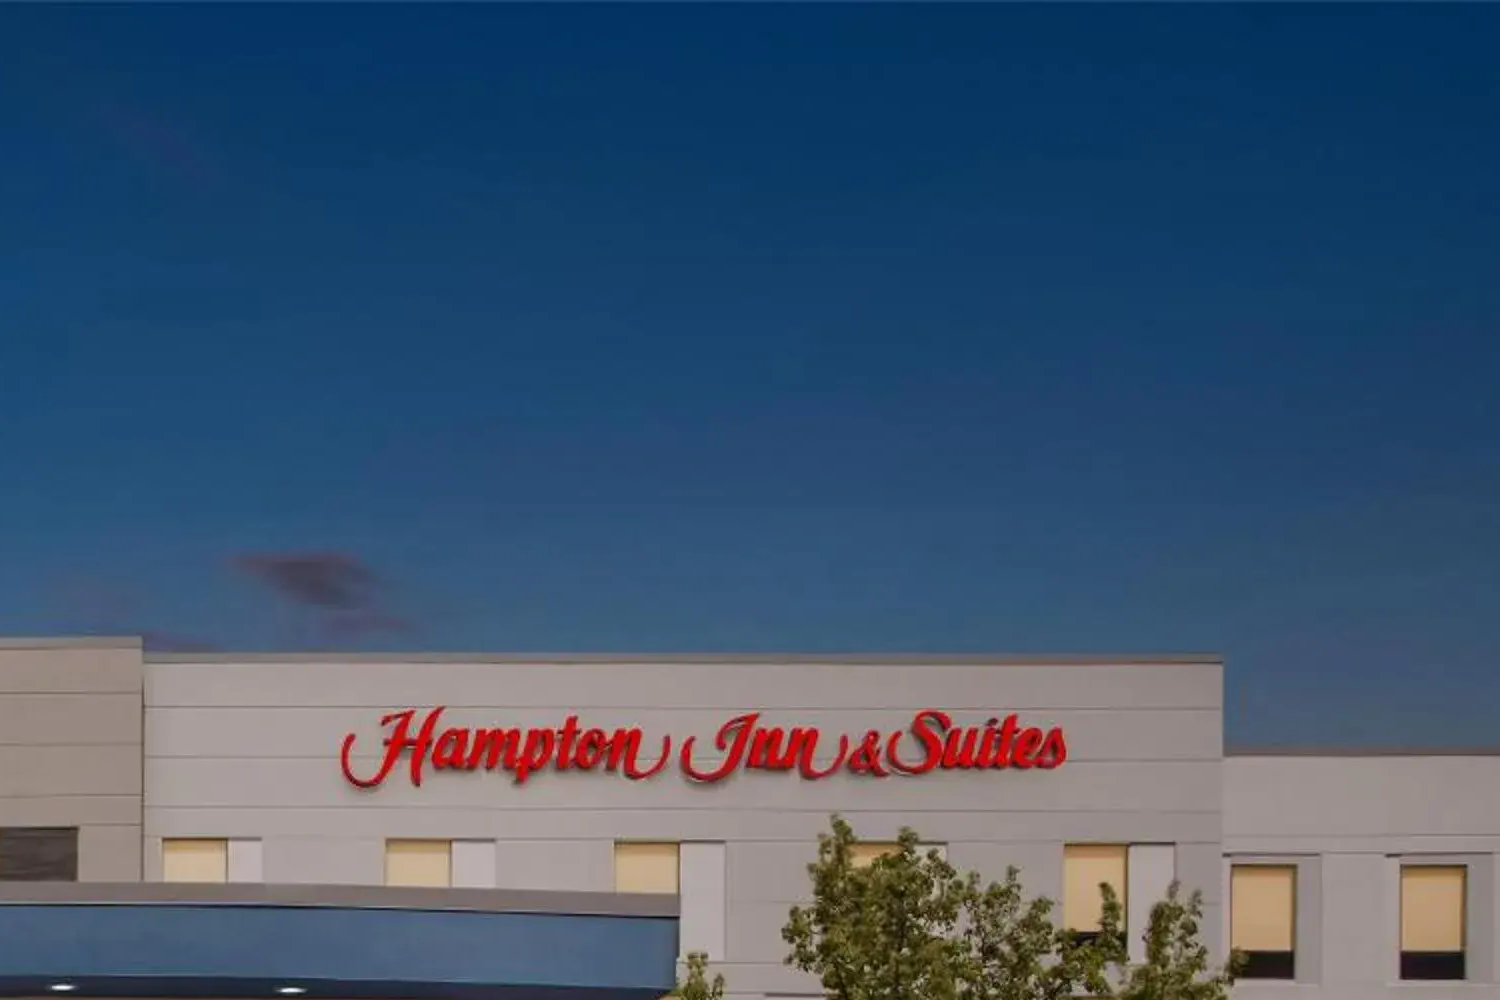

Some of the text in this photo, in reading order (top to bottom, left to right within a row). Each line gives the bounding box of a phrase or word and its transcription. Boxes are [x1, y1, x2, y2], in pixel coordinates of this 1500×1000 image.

[340, 706, 1068, 788] Hampton Inn & Suites
